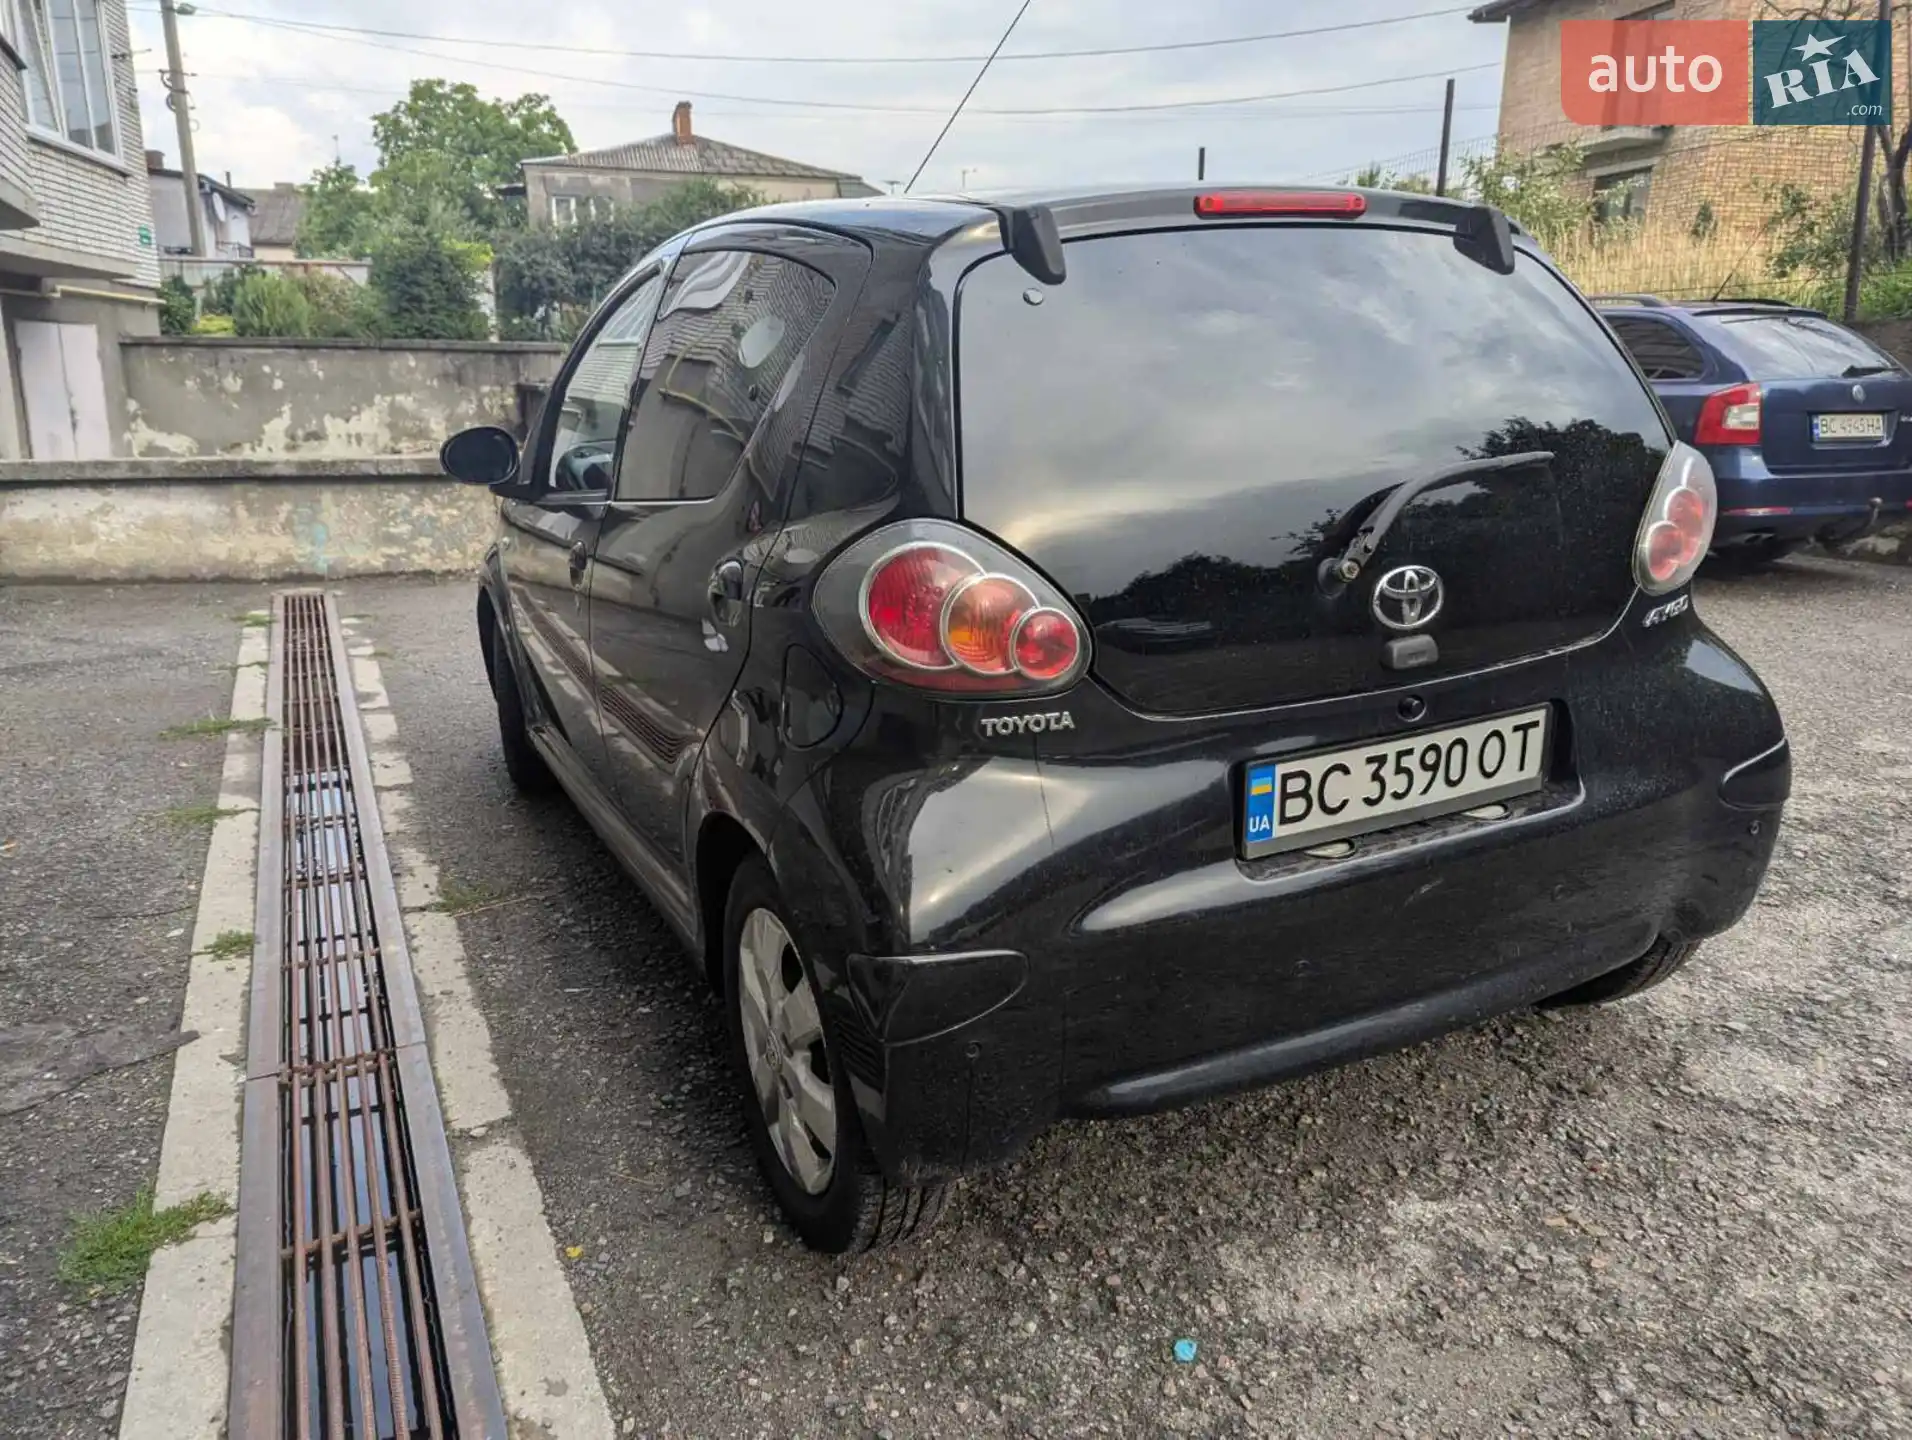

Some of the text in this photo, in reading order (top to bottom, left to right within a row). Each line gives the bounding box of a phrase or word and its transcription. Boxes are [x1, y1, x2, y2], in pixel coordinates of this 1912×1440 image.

[981, 711, 1076, 737] TOYOTA
[1279, 720, 1540, 826] BC 3590 OT
[1249, 814, 1270, 832] UA
